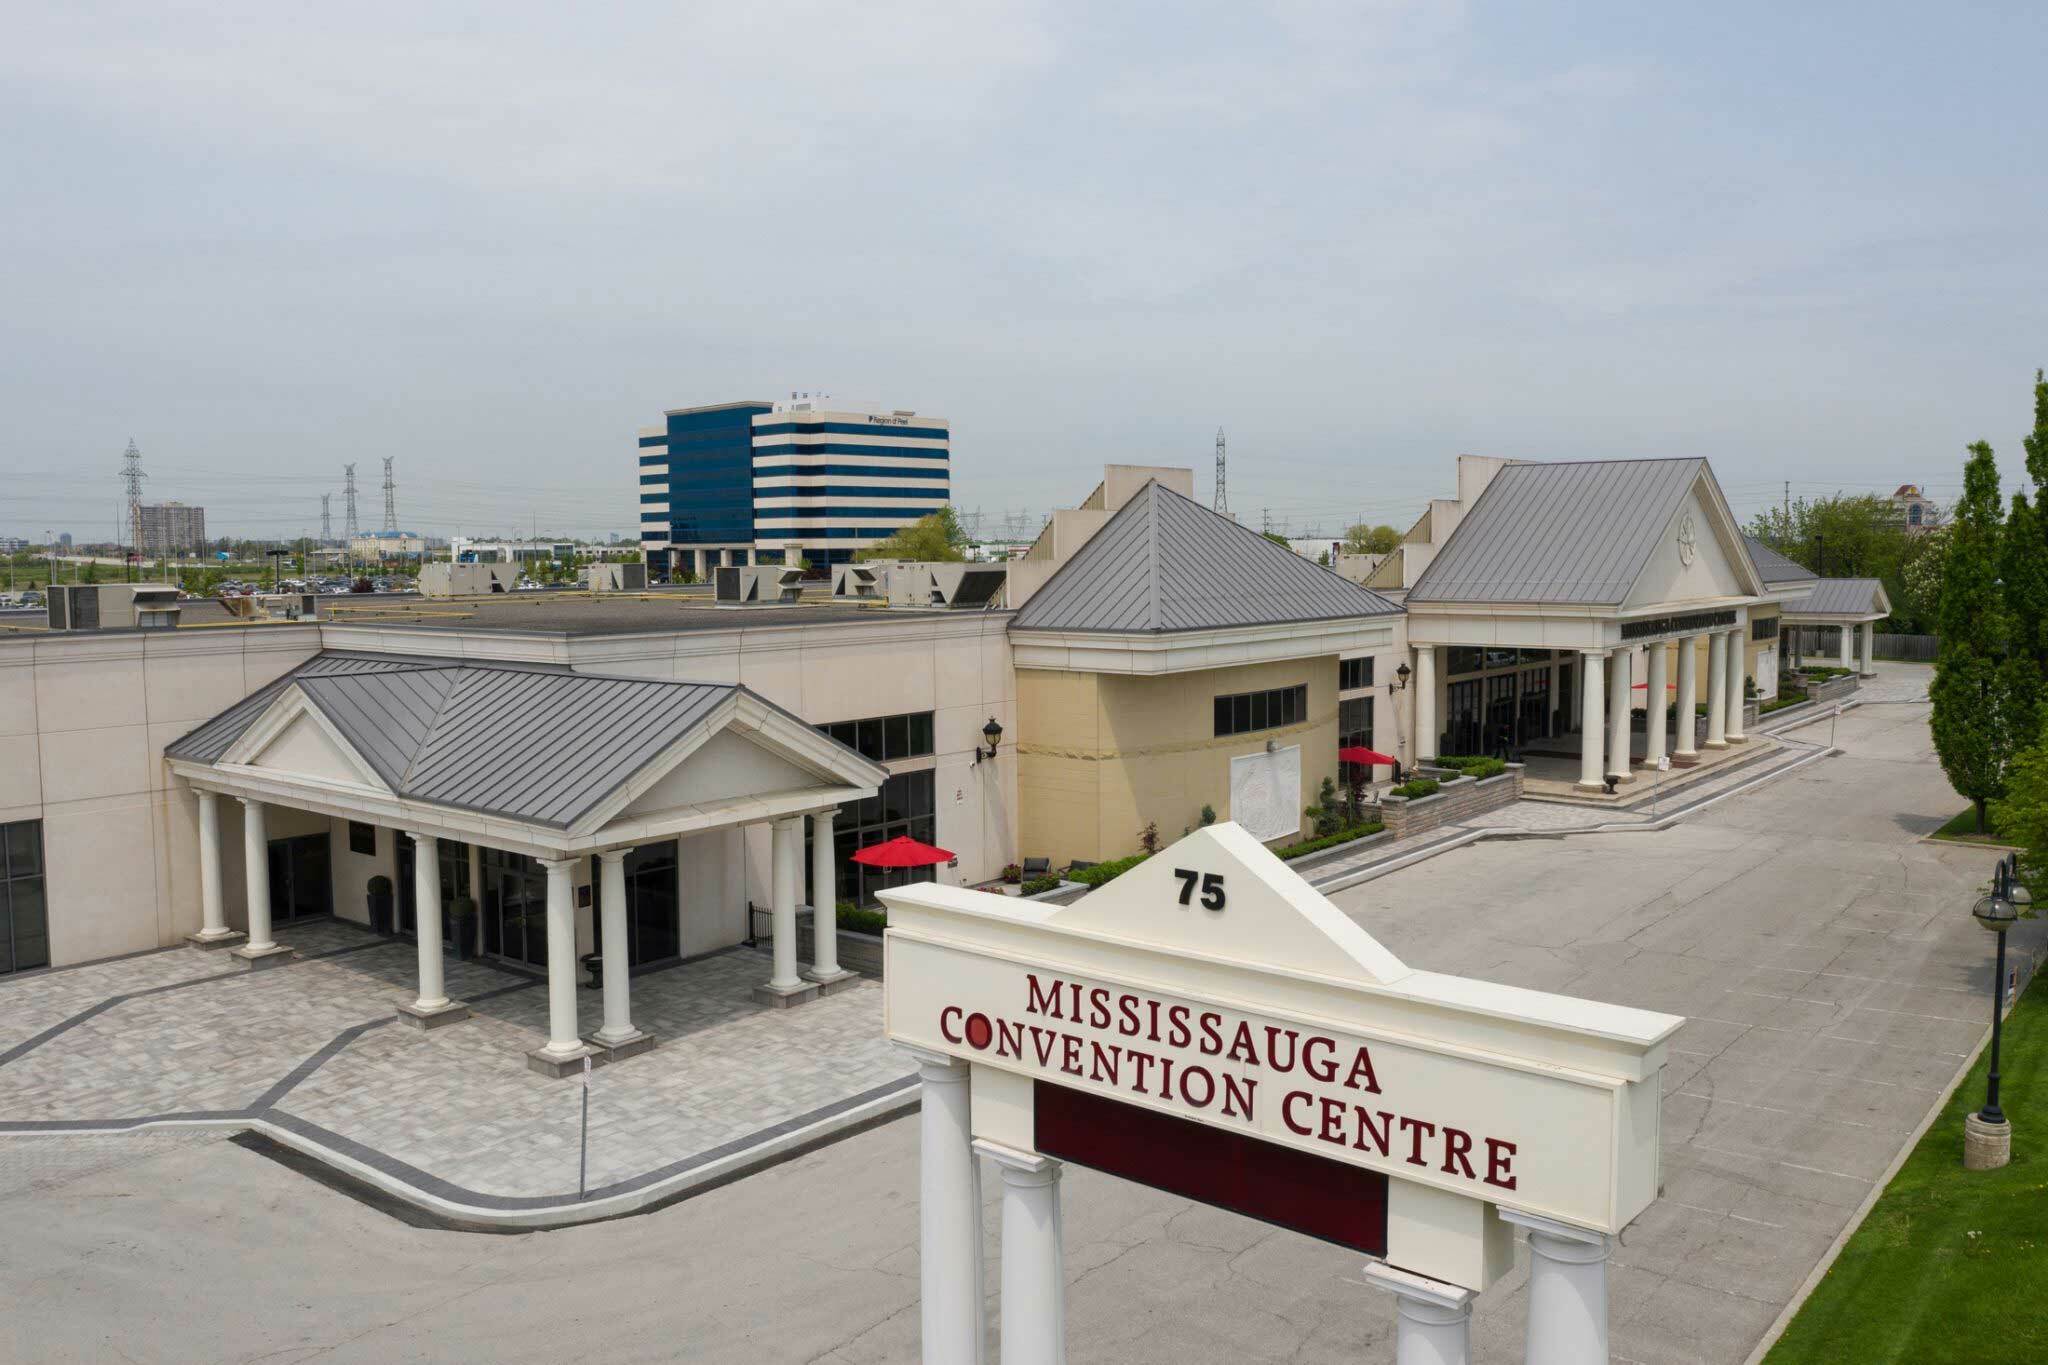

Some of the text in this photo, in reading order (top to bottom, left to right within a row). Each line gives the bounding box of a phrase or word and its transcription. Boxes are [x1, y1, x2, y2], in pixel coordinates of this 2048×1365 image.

[1174, 868, 1226, 911] 75
[1026, 973, 1382, 1095] MISSISSAUGA
[940, 1005, 1517, 1191] CONVENTION CENTRE
